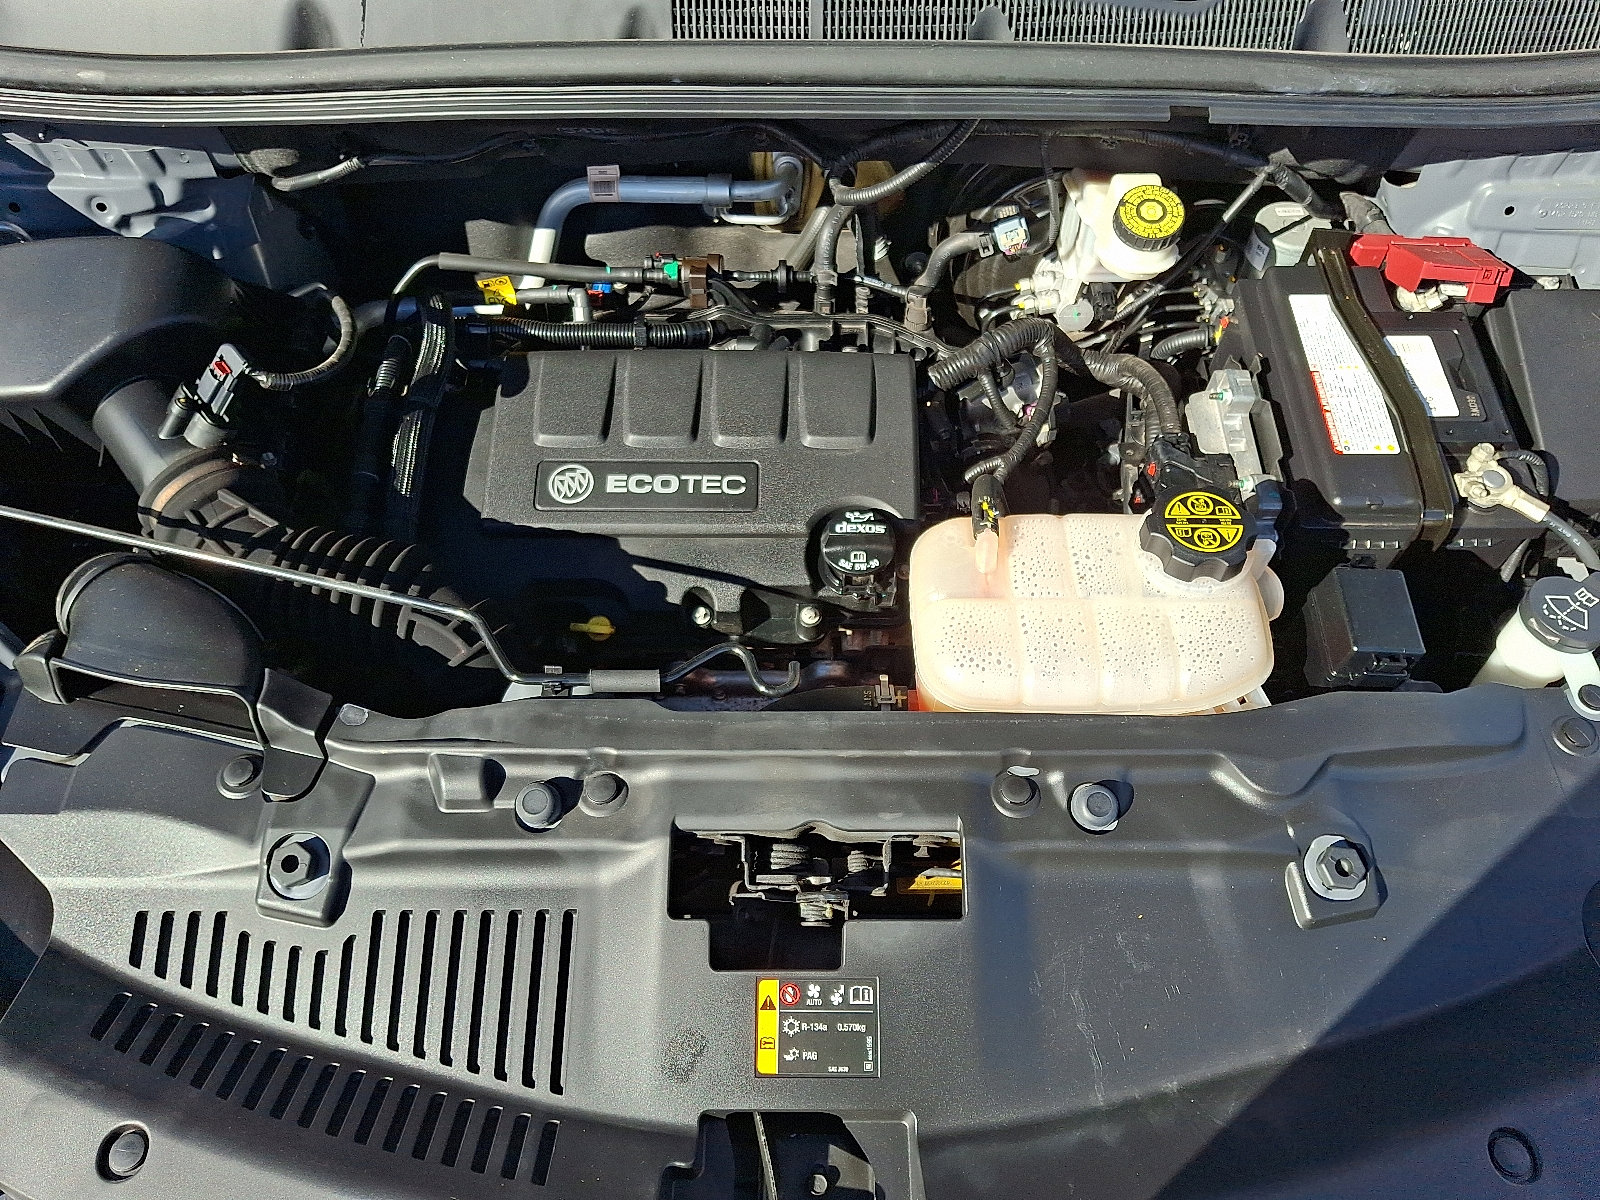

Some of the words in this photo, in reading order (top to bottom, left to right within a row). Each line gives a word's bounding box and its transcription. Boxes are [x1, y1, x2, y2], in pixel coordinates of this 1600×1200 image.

[606, 473, 747, 496] ECOTEC
[835, 521, 887, 534] dexos
[838, 558, 853, 570] SAE
[806, 998, 822, 1006] AUTO
[801, 1022, 828, 1032] R-134a
[837, 1022, 866, 1033] 0.570kg
[802, 1051, 818, 1061] PAG
